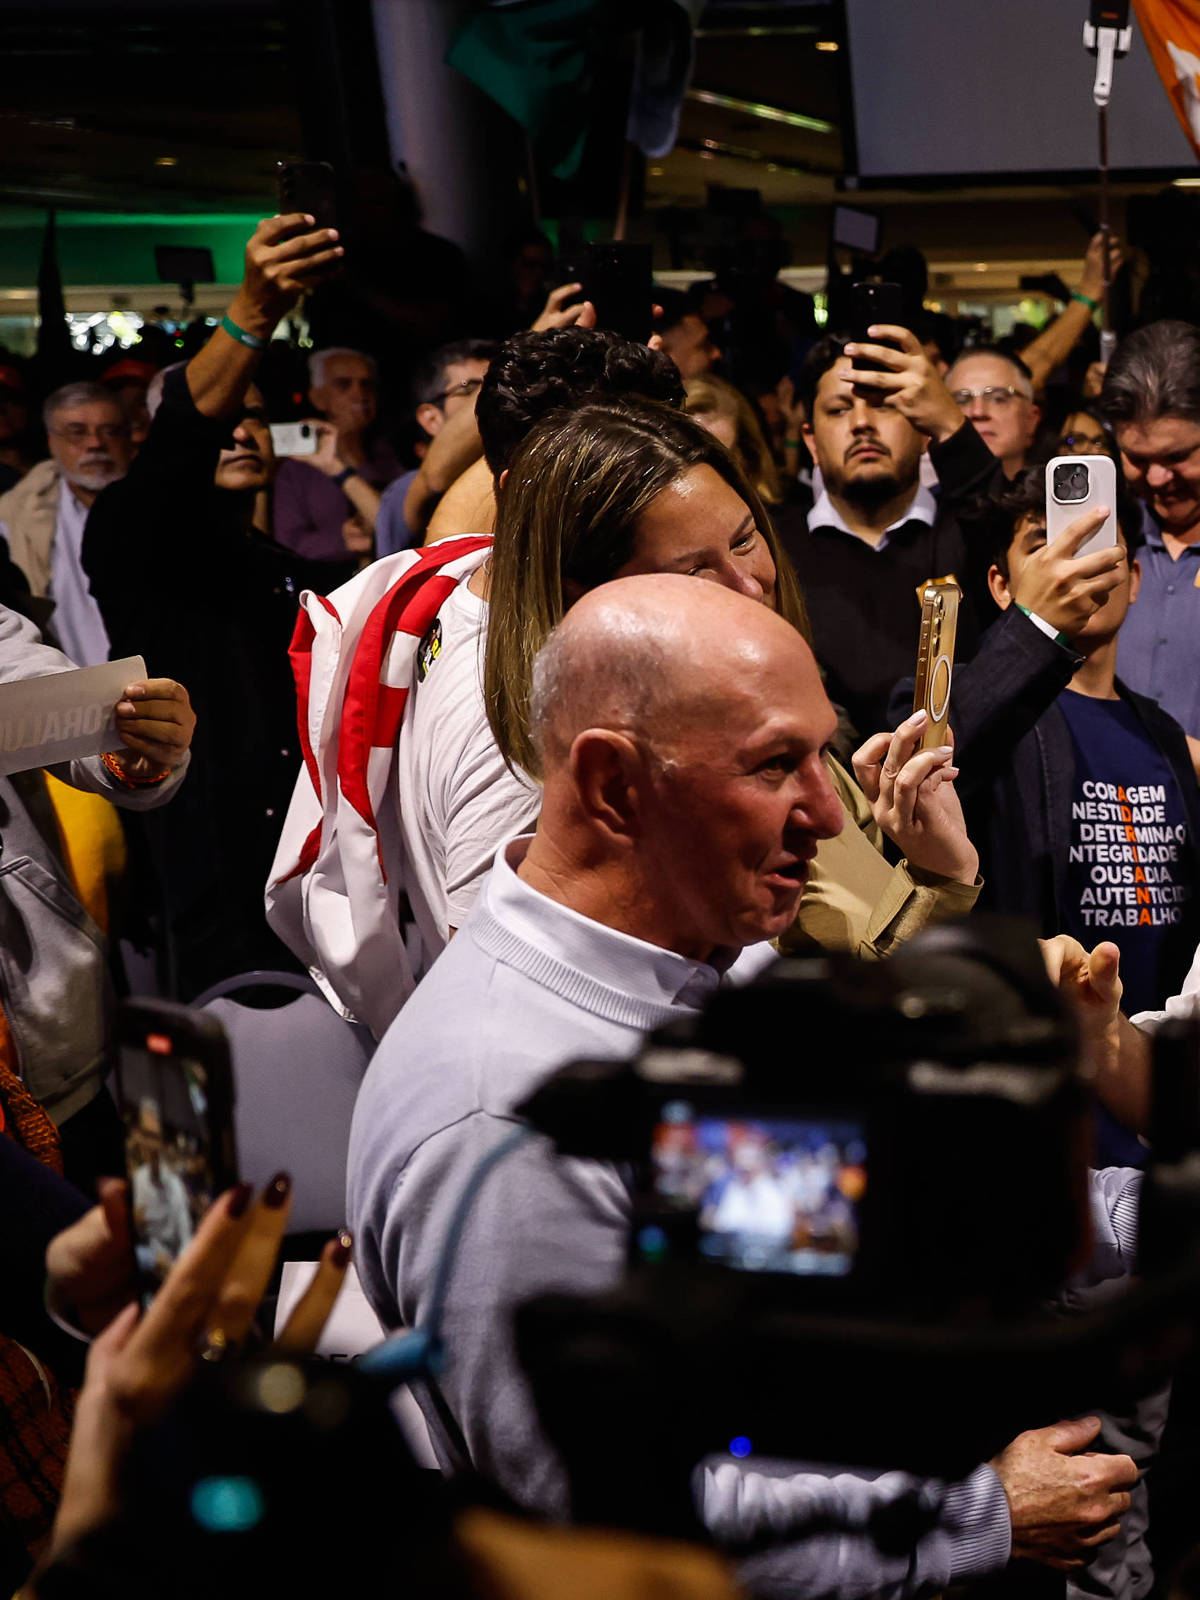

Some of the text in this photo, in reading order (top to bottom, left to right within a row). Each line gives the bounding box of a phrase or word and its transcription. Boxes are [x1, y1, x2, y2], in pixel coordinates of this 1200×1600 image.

[1082, 780, 1166, 804] CORAGEM
[1080, 823, 1186, 845] DETERMINAÇ
[1090, 865, 1173, 884] OUSADIA
[1080, 907, 1182, 927] TRABALHO
